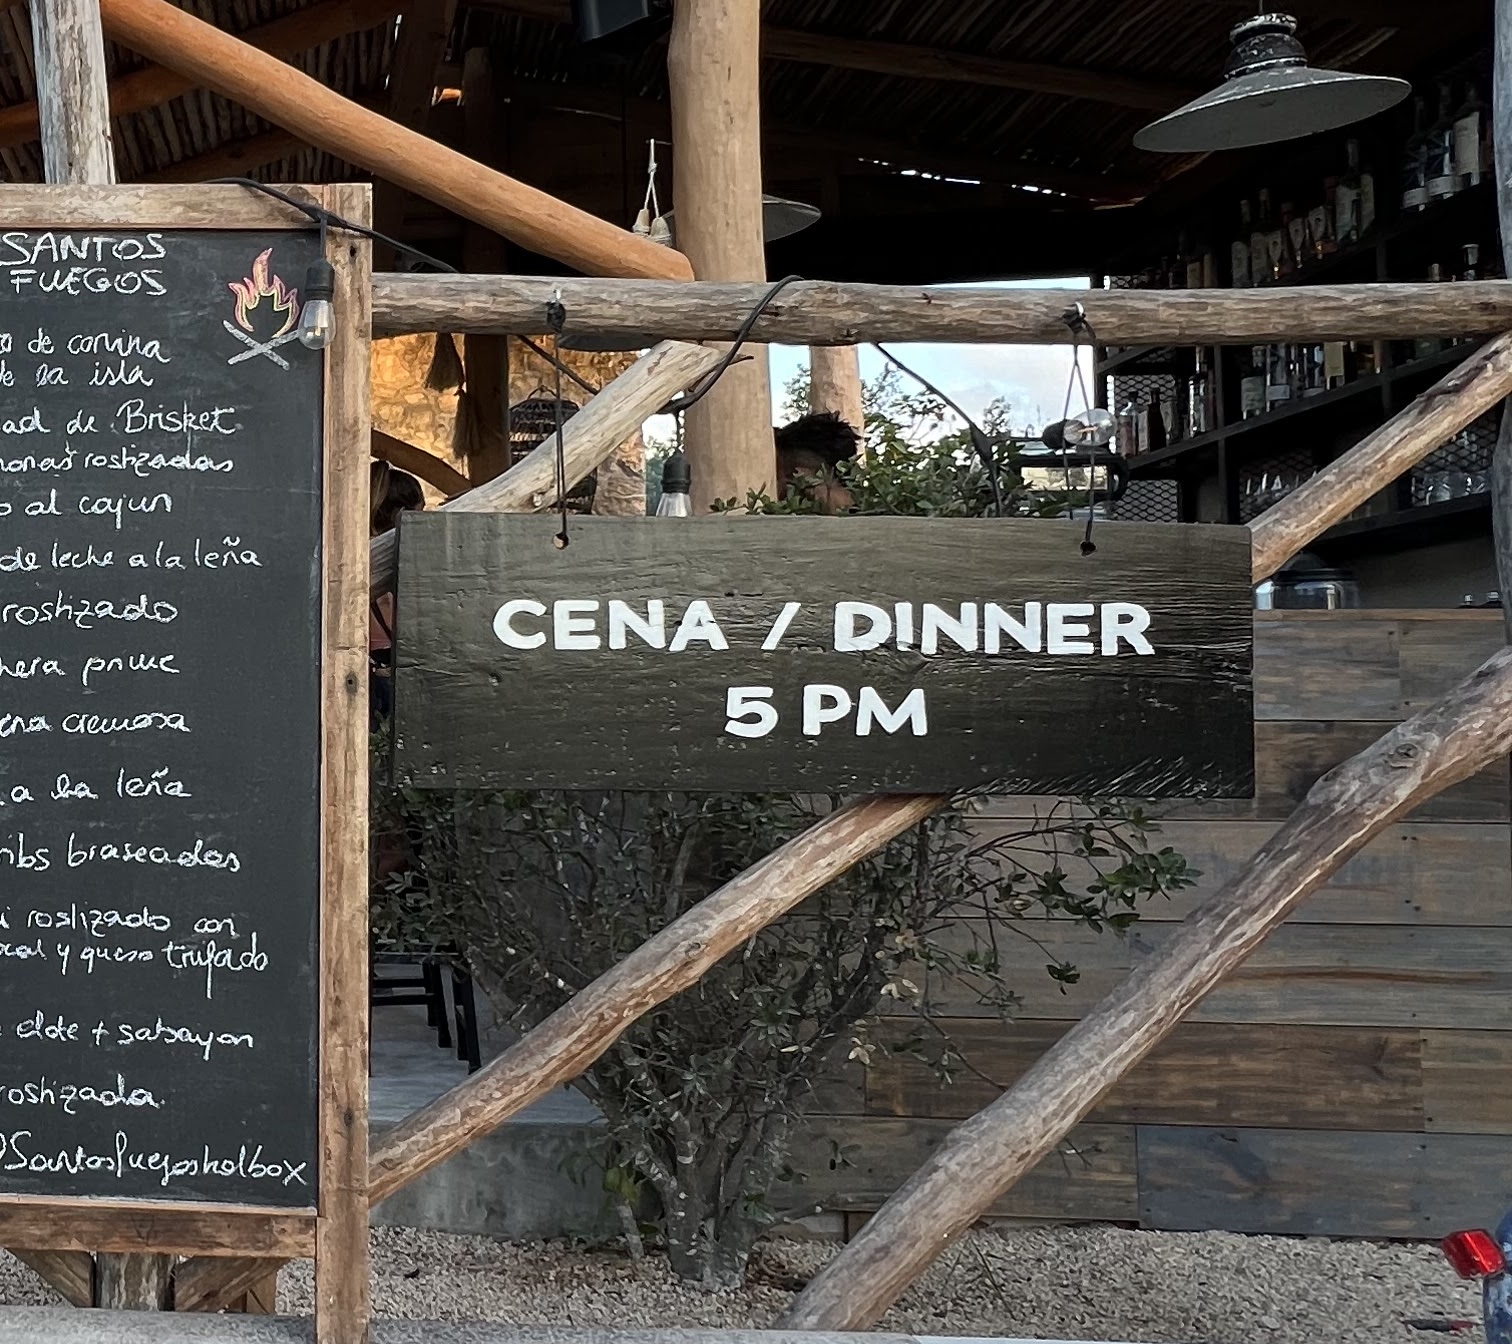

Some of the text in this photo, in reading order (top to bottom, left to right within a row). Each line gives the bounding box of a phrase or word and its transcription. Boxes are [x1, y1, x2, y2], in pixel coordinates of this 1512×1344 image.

[9, 266, 168, 297] FUEGOS
[27, 327, 55, 355] de
[66, 328, 171, 364] corvina
[36, 362, 69, 388] la
[88, 359, 155, 388] isla
[65, 408, 99, 436] de
[116, 398, 237, 437] Brisket
[83, 443, 234, 478] rostizadas
[24, 488, 63, 516] al
[77, 491, 173, 531] cajun
[50, 542, 115, 570] leche
[128, 551, 149, 569] a
[155, 540, 186, 570] la
[193, 535, 264, 570] leña
[1, 589, 180, 630] rostizado
[492, 599, 1157, 656] CENA / DINNER
[724, 683, 929, 739] 5 PM
[9, 786, 35, 803] a
[49, 772, 100, 800] la
[115, 765, 193, 799] leña
[66, 831, 242, 874] braseados
[26, 901, 172, 938] rostizado
[192, 913, 242, 939] con
[55, 943, 71, 976] y
[79, 945, 155, 975] queso
[164, 932, 270, 1001] trufado
[15, 1009, 80, 1042] elote
[90, 1019, 112, 1049] +
[117, 1016, 255, 1062] sabayon
